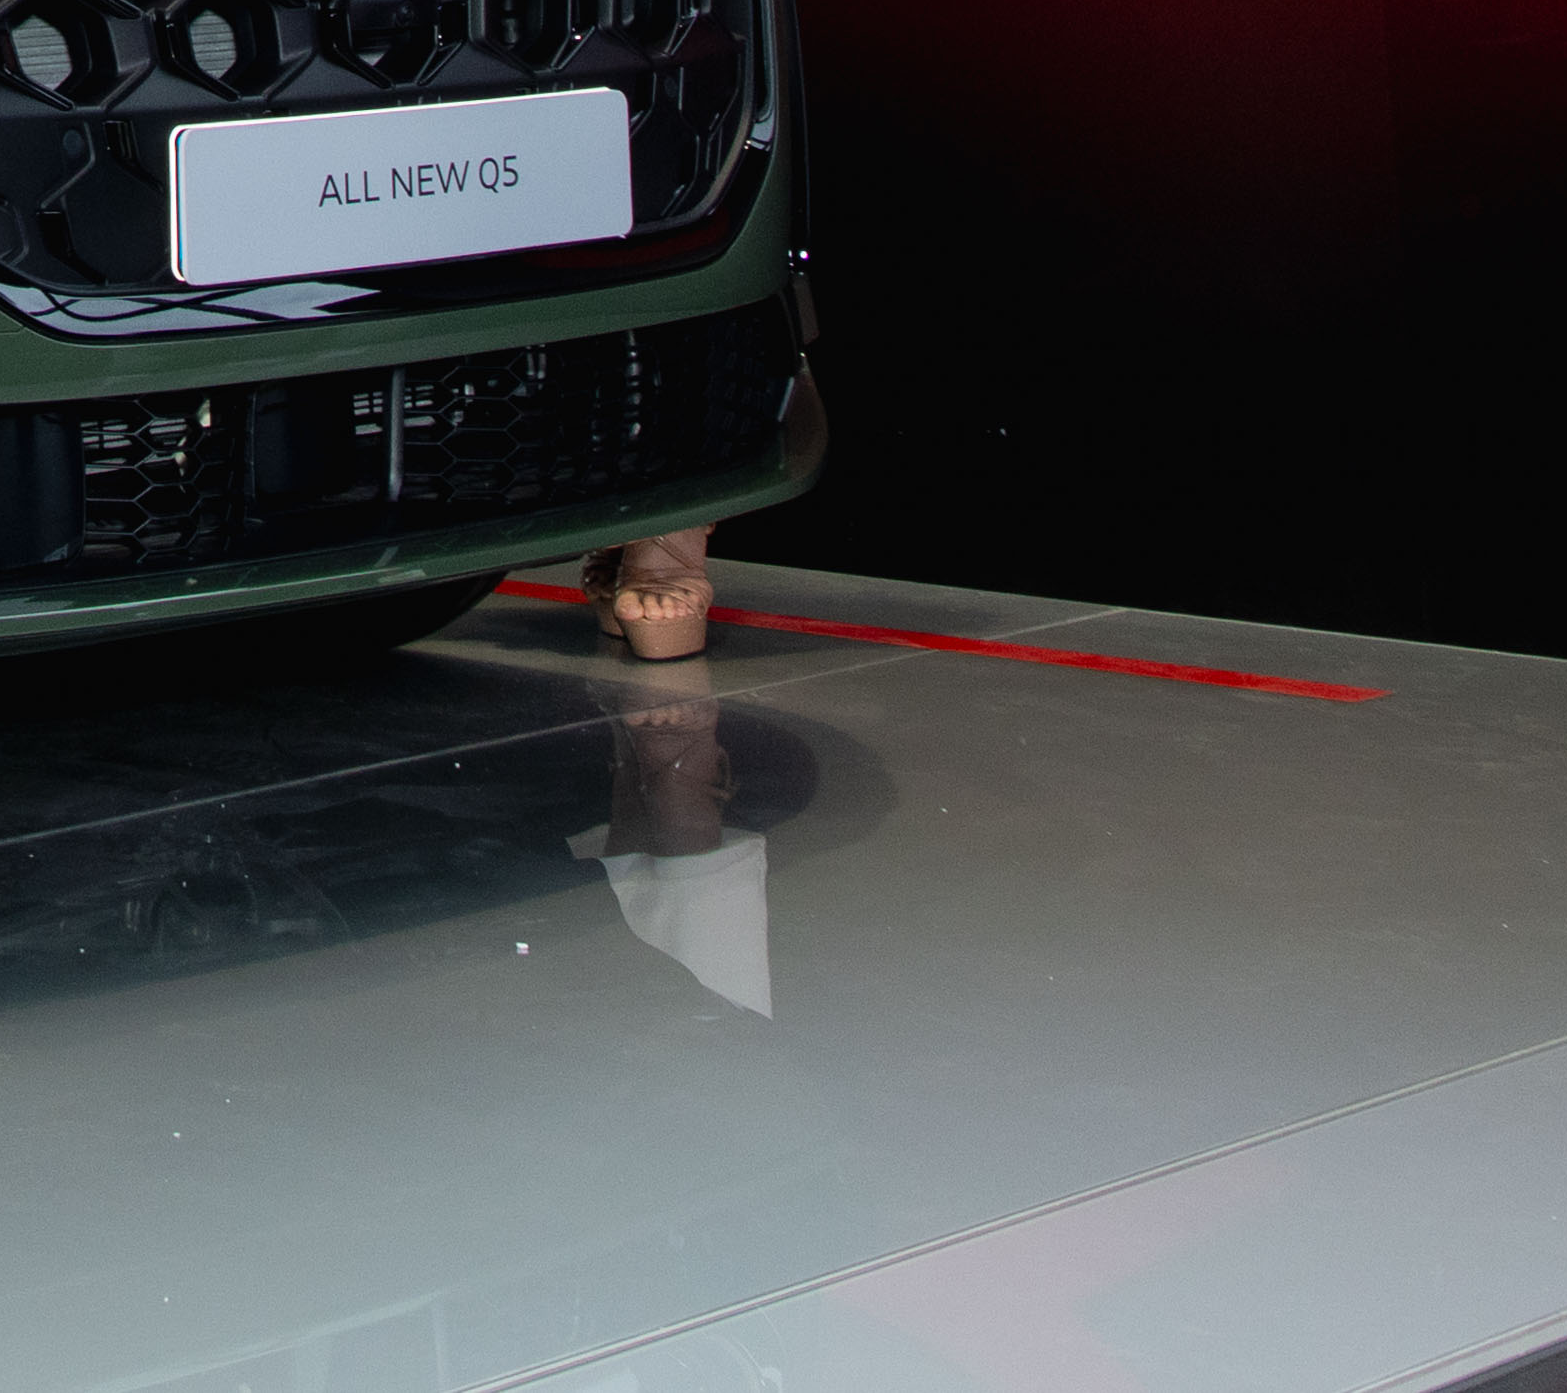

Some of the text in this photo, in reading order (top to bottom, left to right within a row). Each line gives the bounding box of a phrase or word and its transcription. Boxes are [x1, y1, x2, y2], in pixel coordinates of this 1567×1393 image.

[318, 155, 520, 208] ALL NEW Q5
